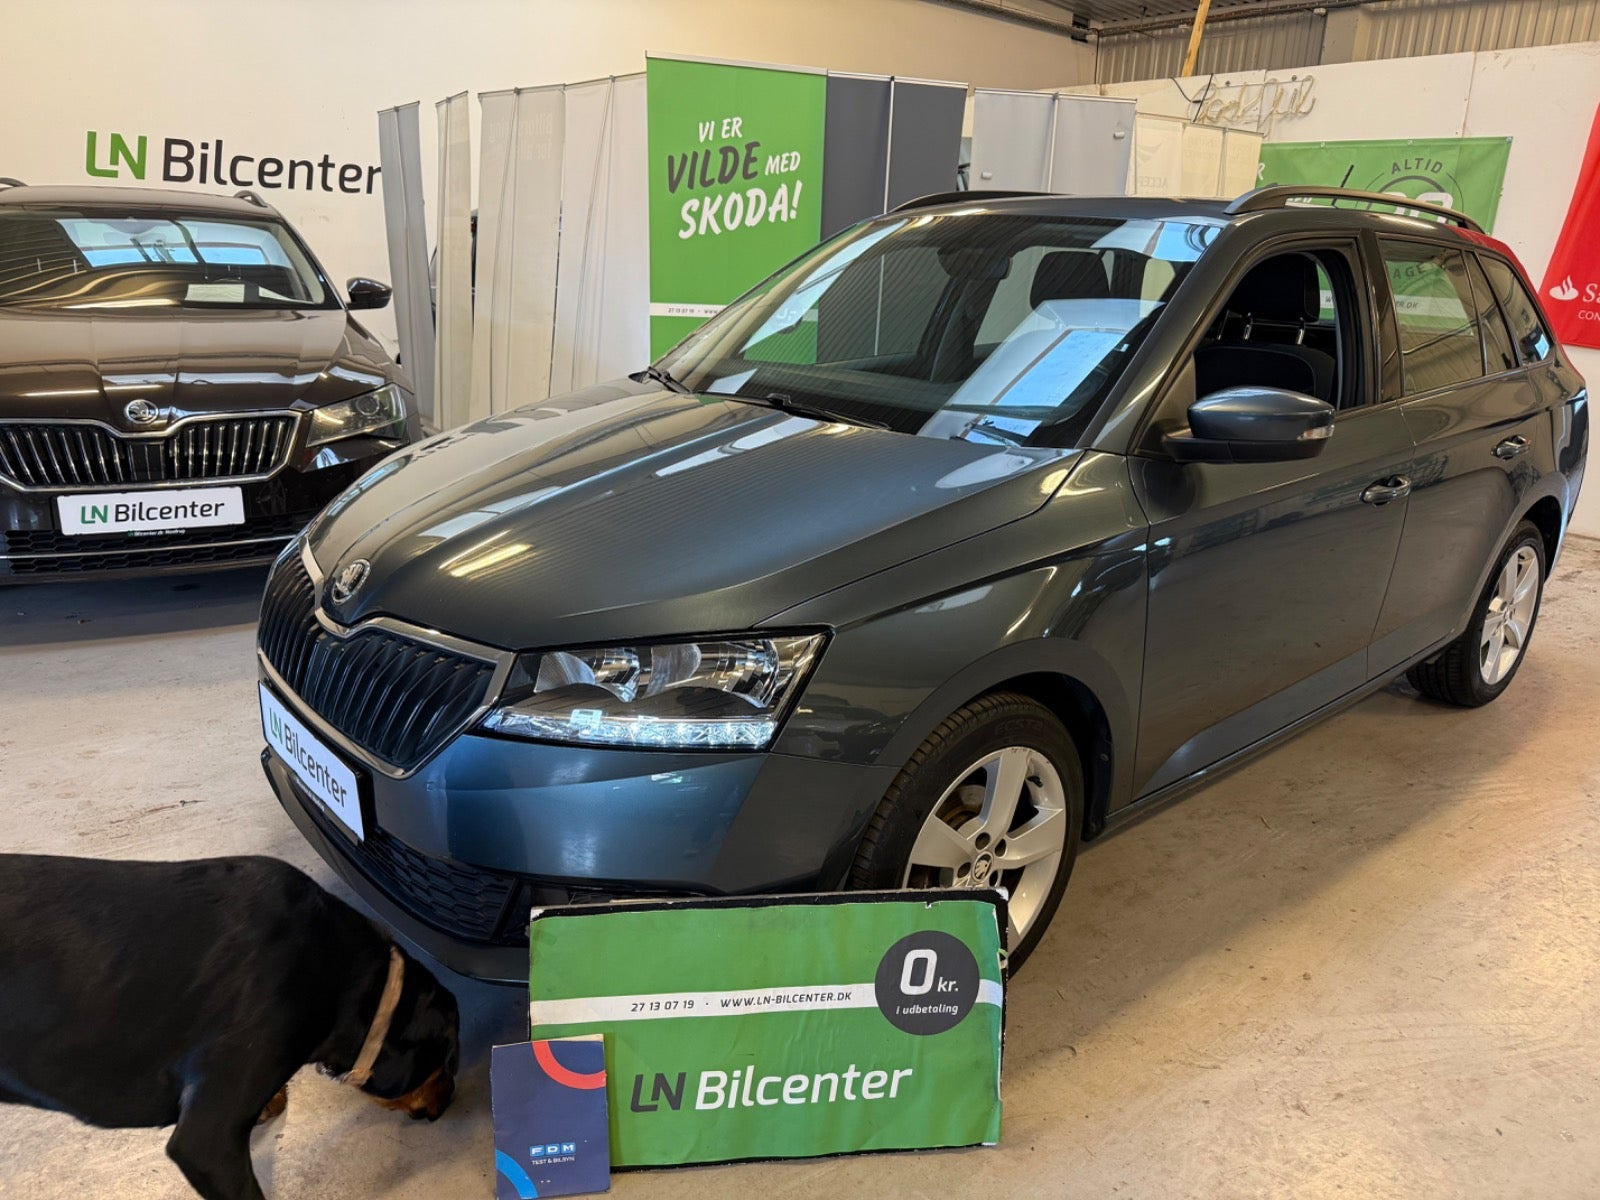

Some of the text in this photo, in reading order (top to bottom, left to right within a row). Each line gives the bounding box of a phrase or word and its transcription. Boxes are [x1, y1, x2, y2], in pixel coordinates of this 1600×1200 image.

[699, 117, 743, 143] VI ER
[86, 131, 382, 194] LN Bilcenter
[668, 141, 801, 194] VILDE MED
[1391, 157, 1443, 174] ALTID
[678, 180, 803, 239] SKODA!
[81, 501, 225, 524] LN Bilcenter
[269, 707, 283, 745] LN
[284, 723, 347, 807] Bilcenter
[900, 949, 959, 996] 0 kr.
[631, 991, 852, 1012] 27 13 07 19 WWW.LN-BILCENTER.DK
[902, 1003, 959, 1016] udbetaling
[630, 1064, 913, 1112] LN Bilcenter
[531, 1144, 574, 1155] FDM
